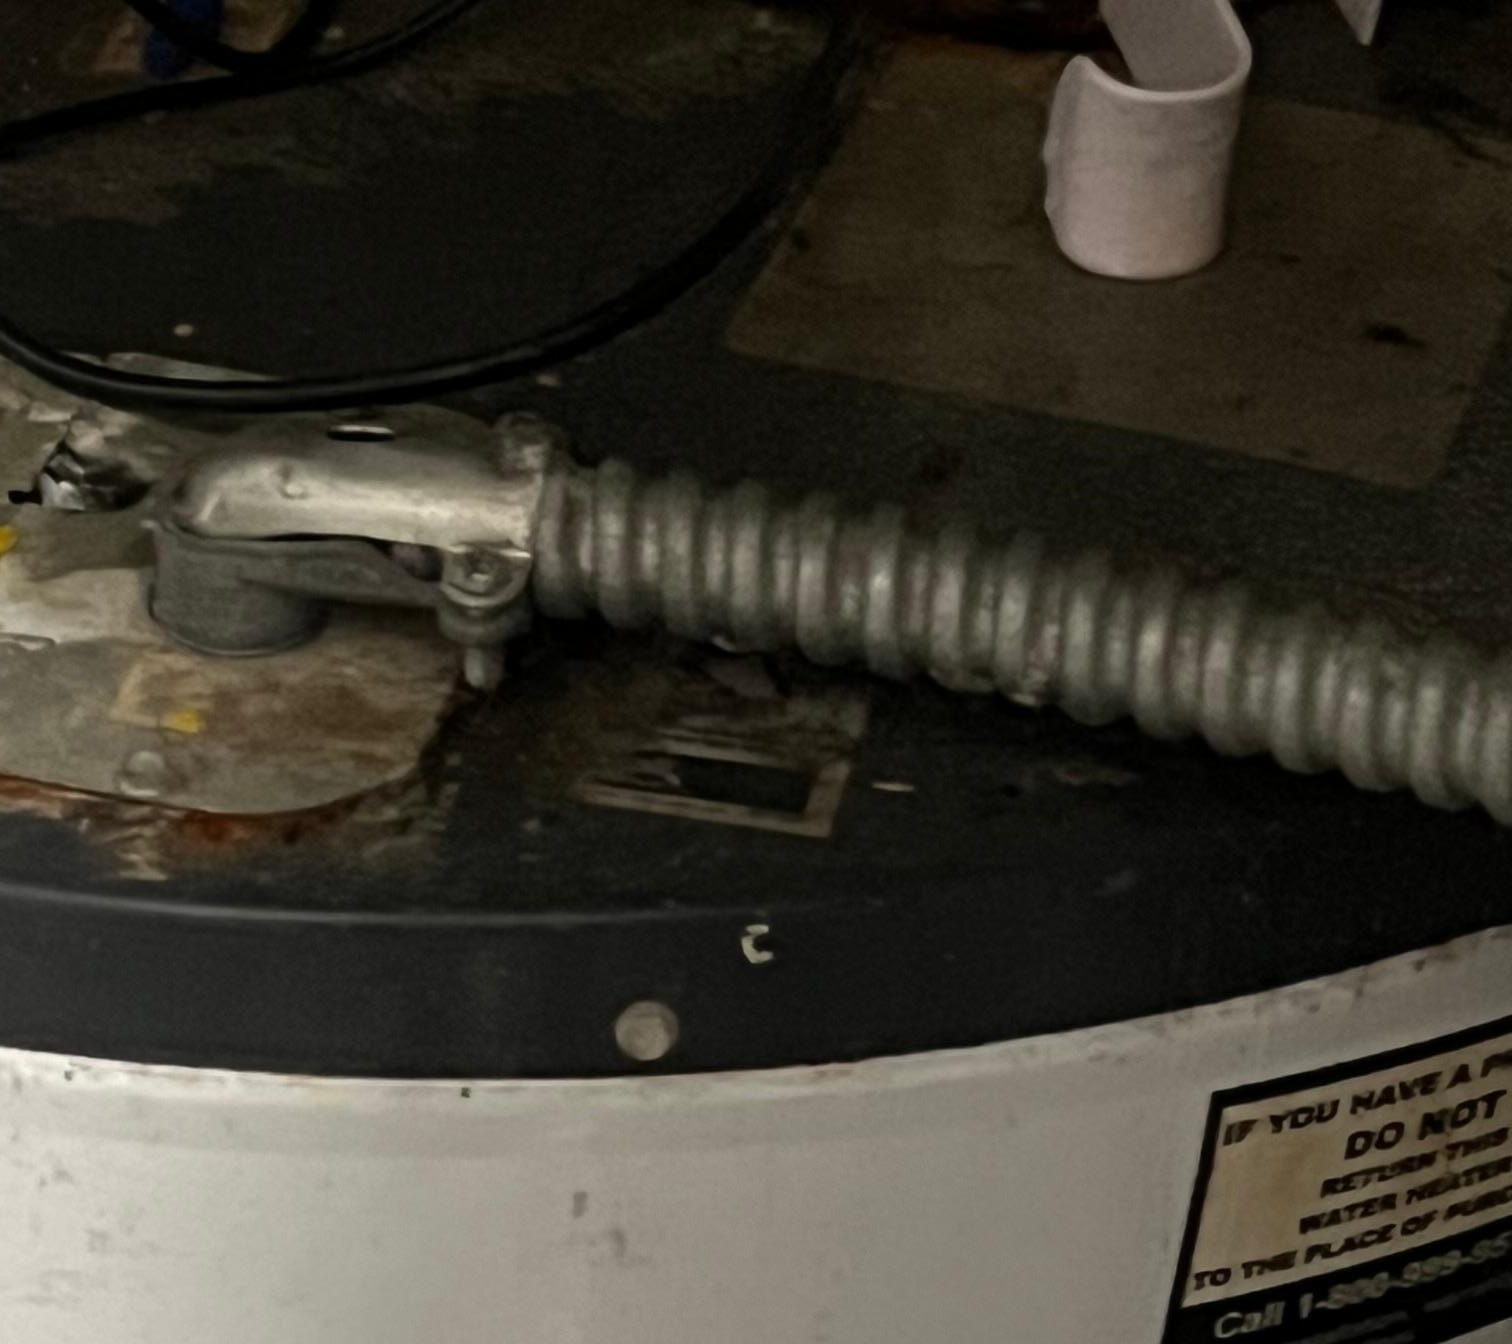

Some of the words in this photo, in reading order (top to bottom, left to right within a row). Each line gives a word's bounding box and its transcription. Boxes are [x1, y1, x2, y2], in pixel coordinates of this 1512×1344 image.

[1223, 1118, 1259, 1147] IF
[1268, 1099, 1340, 1134] YOU
[1349, 1071, 1443, 1114] HAVE
[1445, 1063, 1472, 1090] A
[1344, 1121, 1406, 1160] DO
[1417, 1090, 1509, 1141] NOT
[1192, 1267, 1232, 1291] TO
[1241, 1250, 1297, 1280] THE
[1304, 1222, 1397, 1264] PLACE
[1399, 1209, 1439, 1238] OF
[1213, 1300, 1287, 1339] Call
